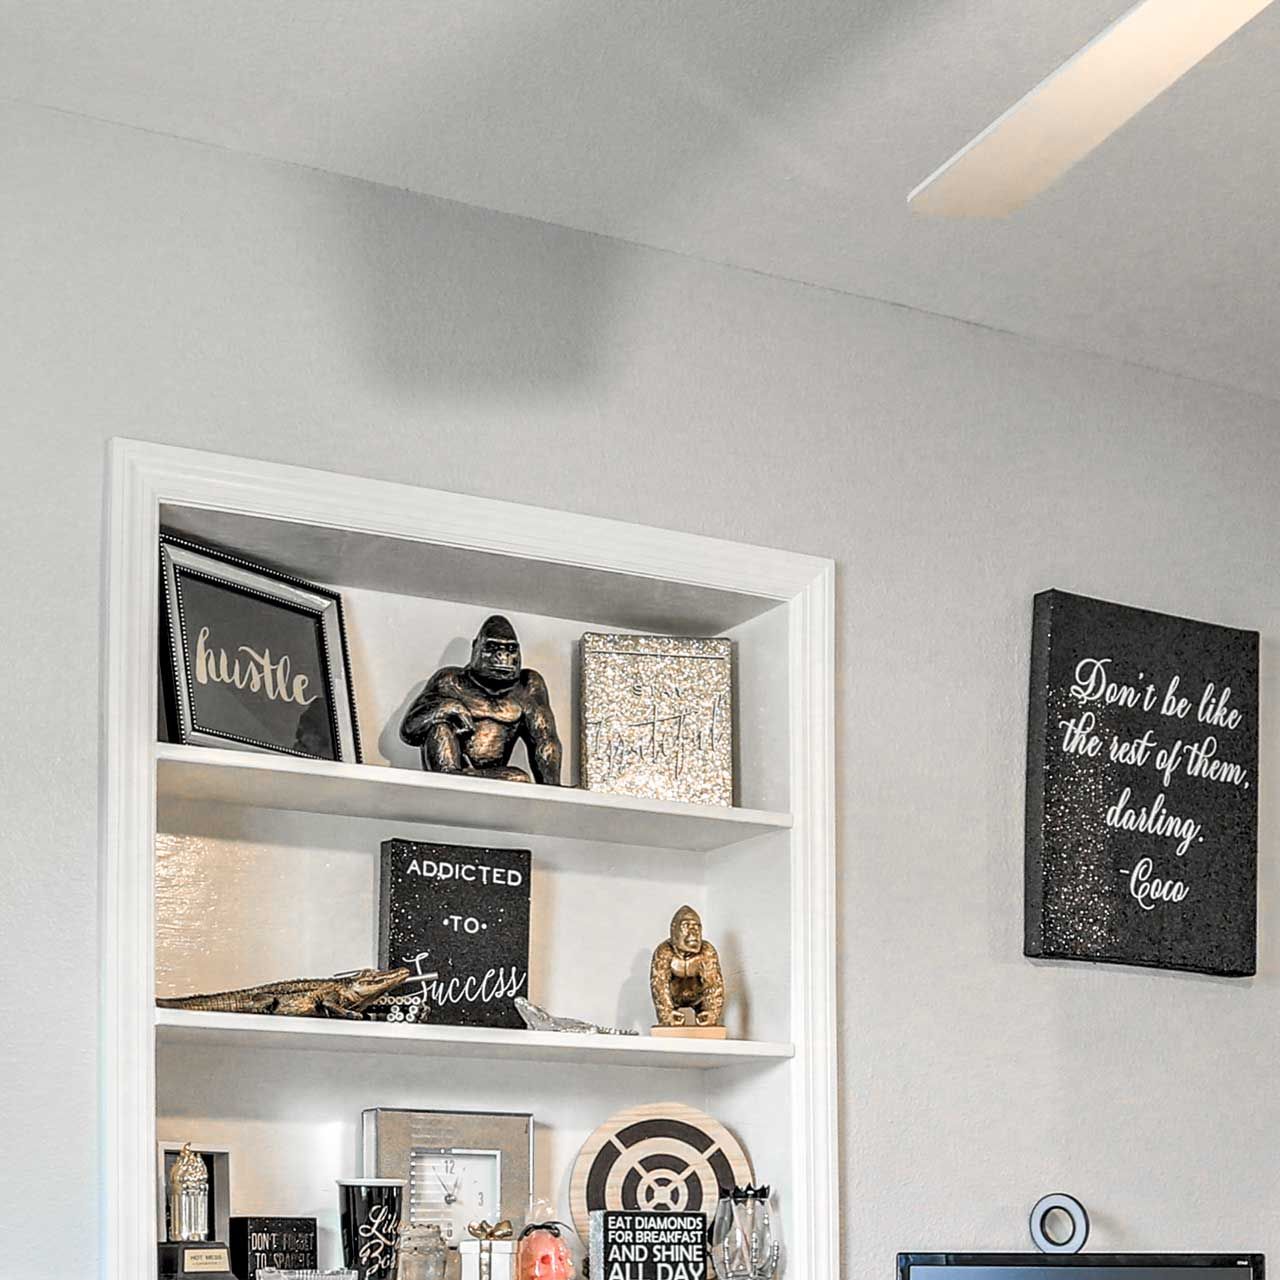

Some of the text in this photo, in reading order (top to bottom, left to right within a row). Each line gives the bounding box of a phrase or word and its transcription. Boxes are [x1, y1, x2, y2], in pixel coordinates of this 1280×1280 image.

[196, 626, 319, 706] hustle
[1070, 658, 1243, 731] Don't be like
[1058, 711, 1250, 789] the rest of them,
[1105, 787, 1205, 856] darling.
[406, 859, 523, 887] ADDICTED
[401, 952, 527, 1007] Success
[443, 1160, 456, 1175] 12
[478, 1191, 484, 1207] 3
[359, 1204, 399, 1246] Lik
[607, 1216, 704, 1230] EAT DIAMONDS
[607, 1230, 704, 1243] FOR BREAKFAST
[254, 1252, 267, 1269] TO
[608, 1244, 704, 1262] AND SHINE
